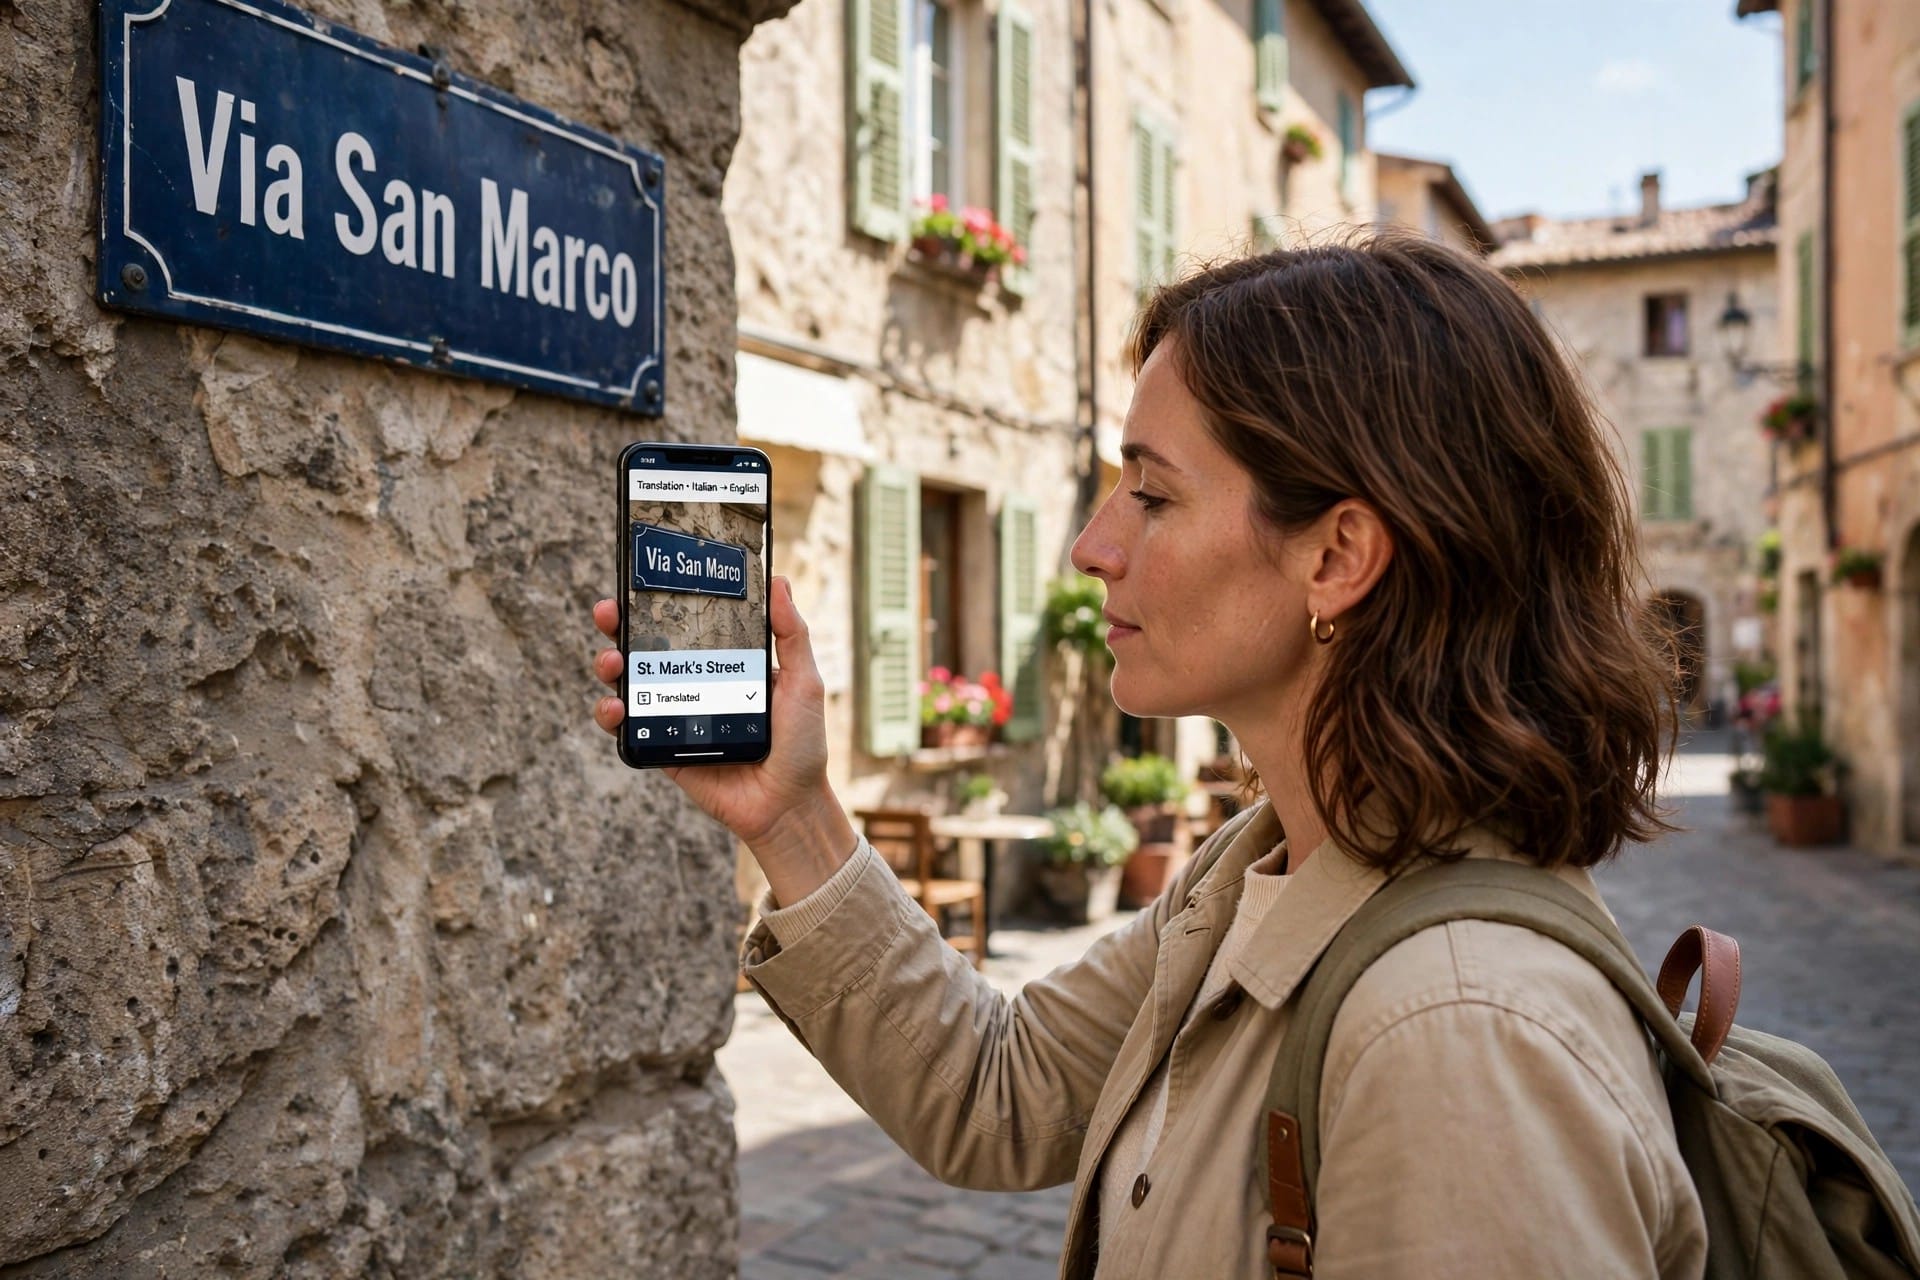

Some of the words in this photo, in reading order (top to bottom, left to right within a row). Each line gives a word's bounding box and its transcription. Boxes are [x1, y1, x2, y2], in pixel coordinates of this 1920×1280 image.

[175, 75, 305, 241] Via
[334, 131, 456, 280] San
[480, 177, 638, 329] Marco
[637, 480, 684, 491] Translation
[692, 481, 718, 492] Italian
[729, 483, 760, 495] English
[646, 546, 671, 574] Via
[676, 552, 702, 578] San
[706, 557, 741, 583] Marco
[637, 661, 655, 675] St.
[659, 660, 703, 675] Mark's
[706, 660, 746, 674] Street
[656, 692, 700, 703] Translated
